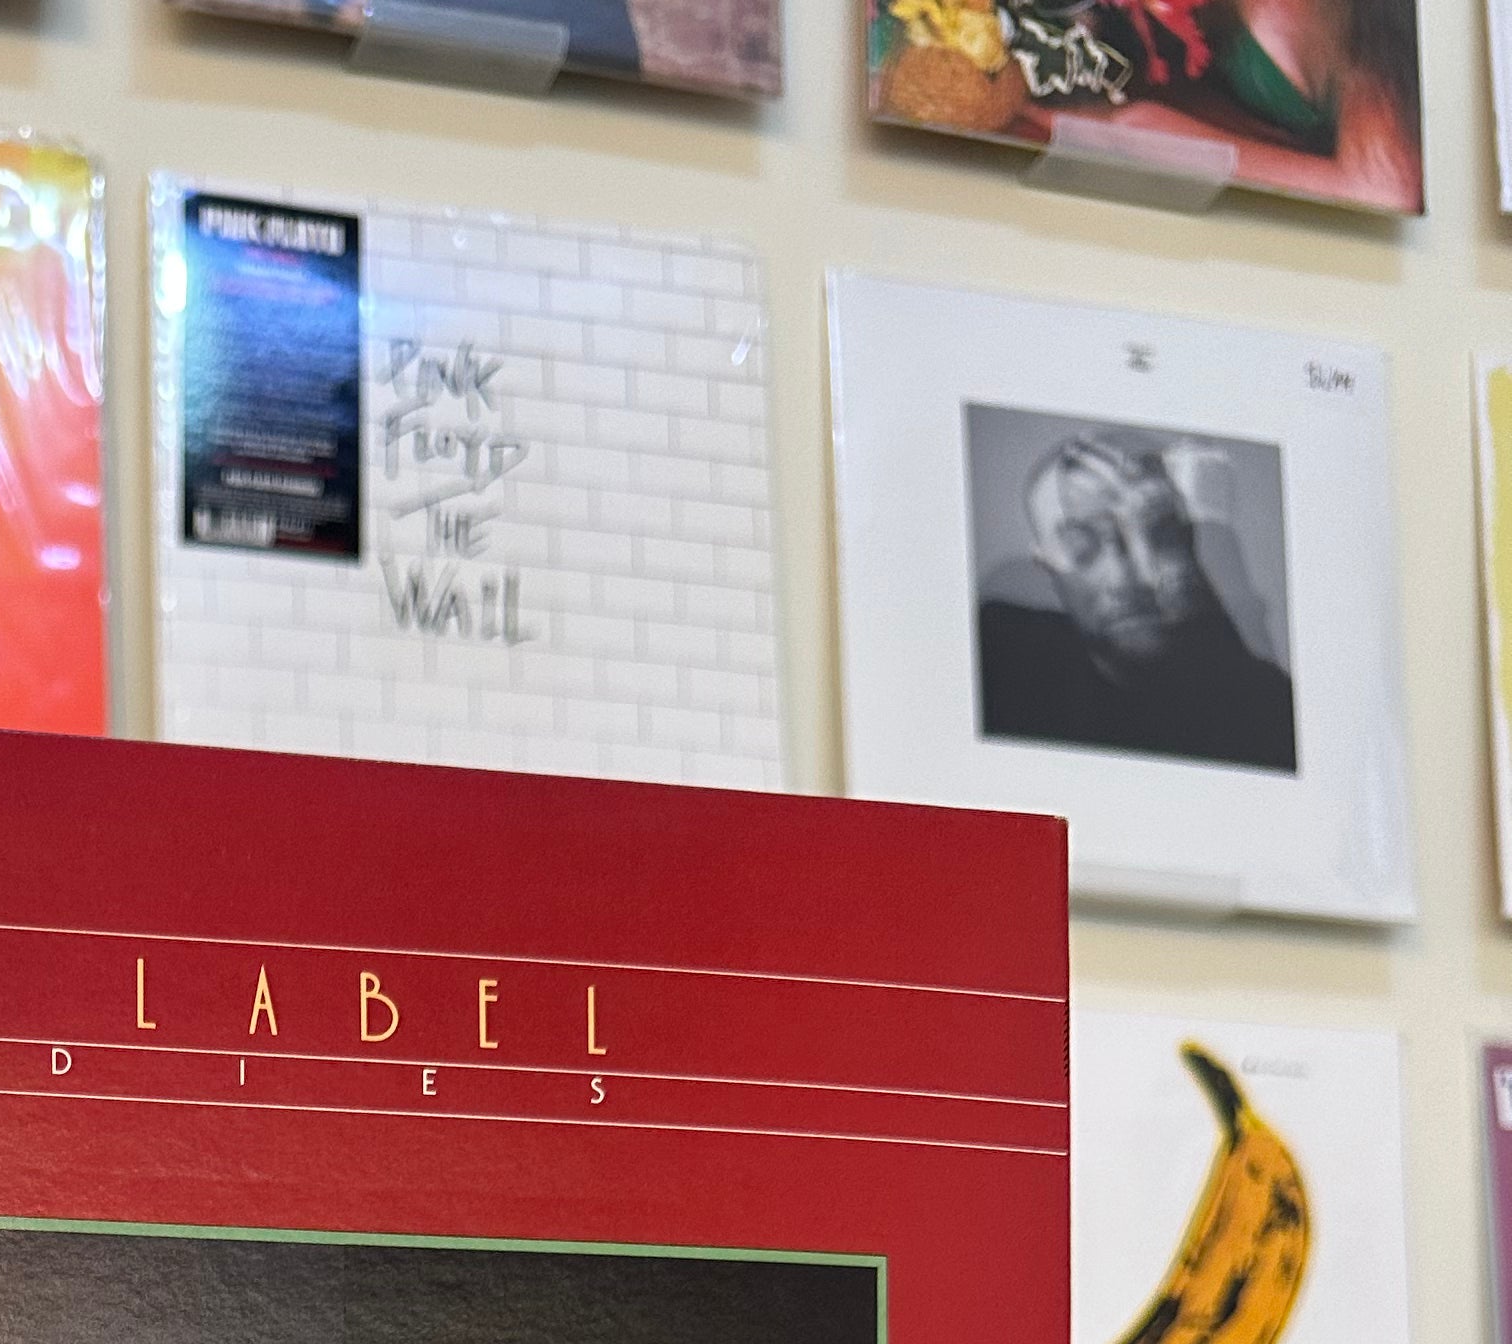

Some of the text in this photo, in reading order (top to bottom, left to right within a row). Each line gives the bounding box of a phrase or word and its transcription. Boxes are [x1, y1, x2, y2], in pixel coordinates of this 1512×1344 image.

[375, 337, 504, 422] PINK
[373, 400, 531, 492] FLOYD
[376, 555, 536, 646] WALL
[136, 957, 608, 1056] LABEL
